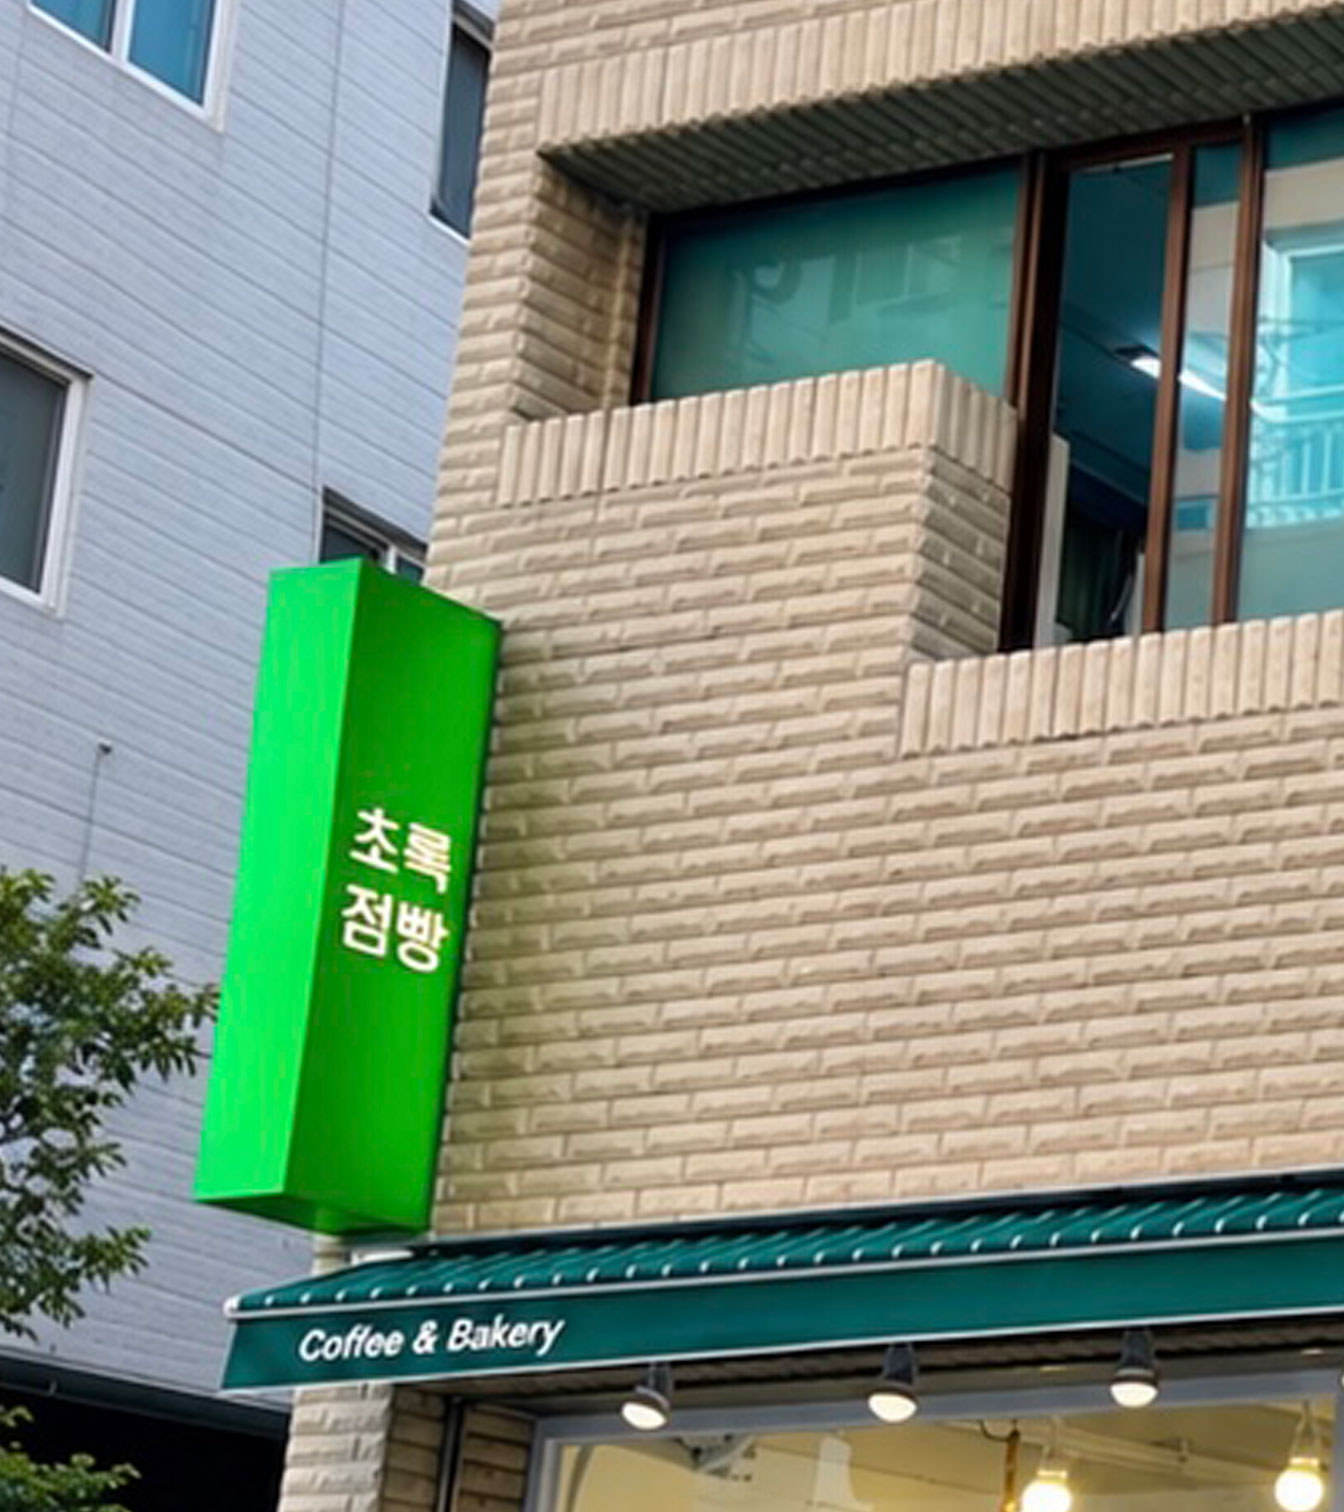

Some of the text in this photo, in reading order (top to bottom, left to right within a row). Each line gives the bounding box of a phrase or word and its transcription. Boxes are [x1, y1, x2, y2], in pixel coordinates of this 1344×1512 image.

[350, 807, 452, 895] 초록
[341, 883, 449, 973] 점빵
[299, 1314, 565, 1361] Coffee & Bakery
